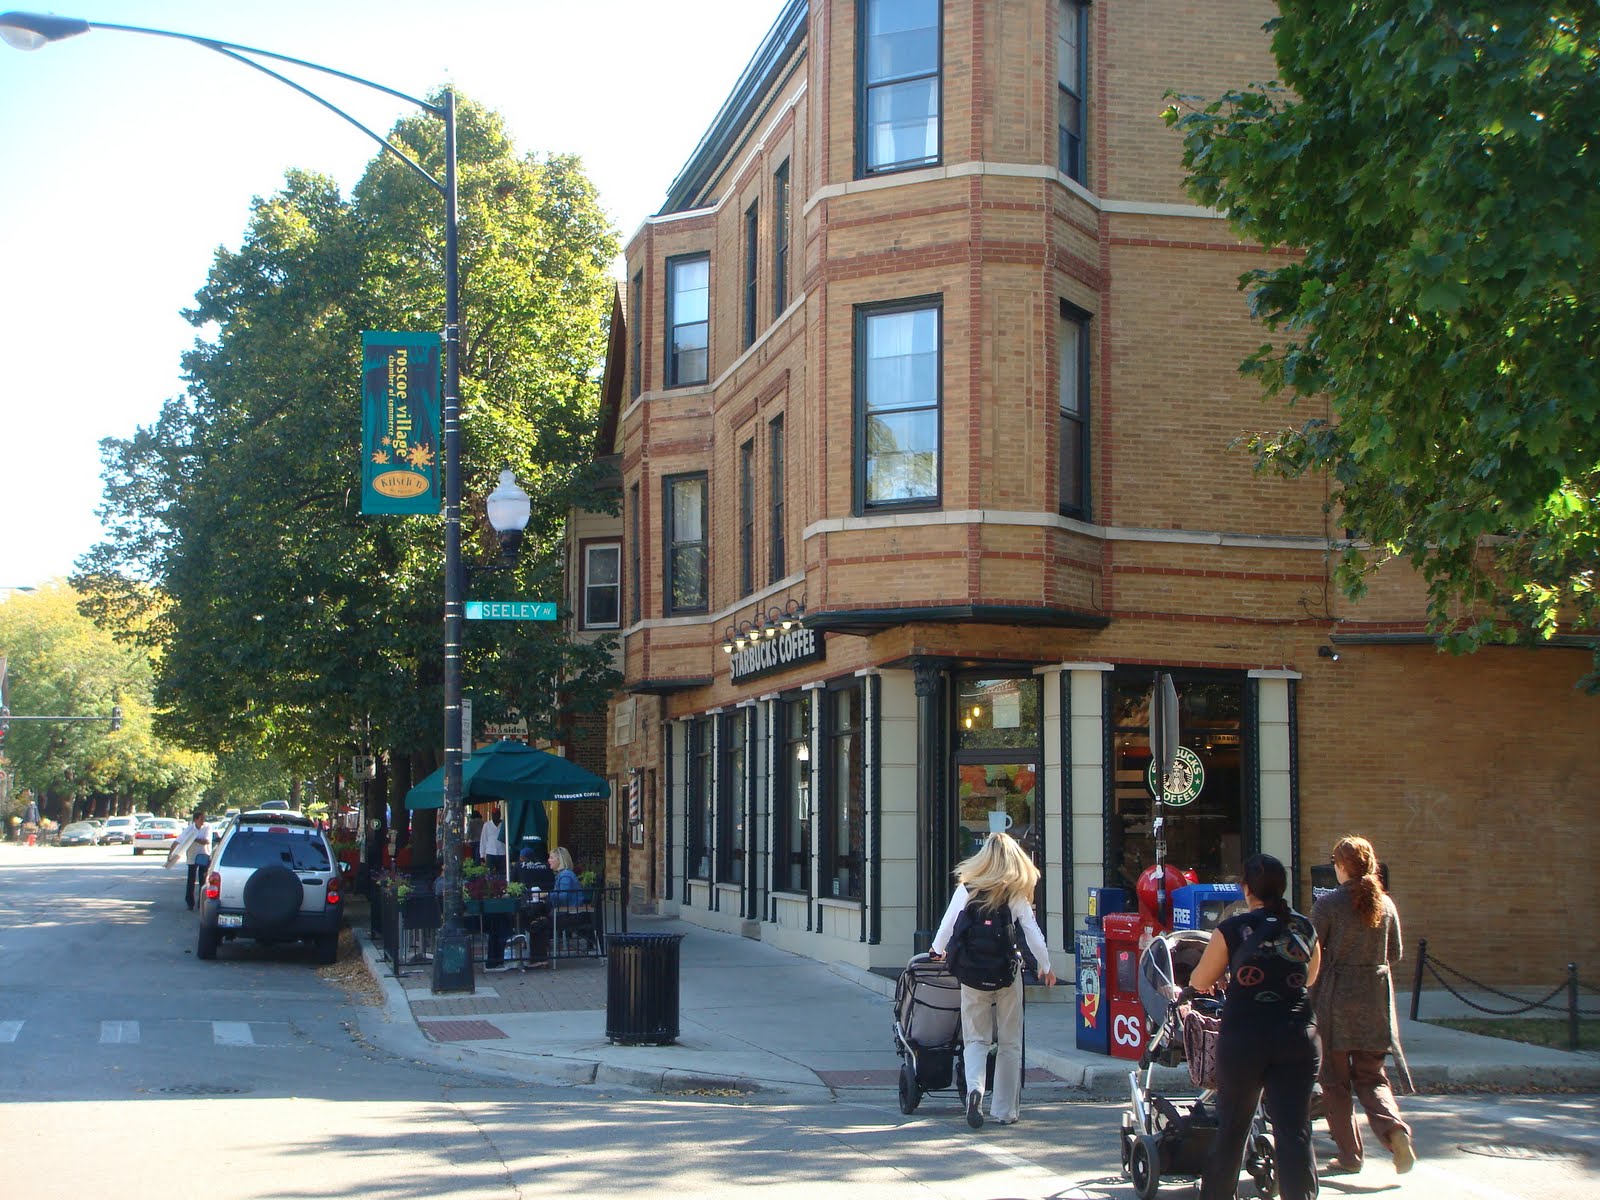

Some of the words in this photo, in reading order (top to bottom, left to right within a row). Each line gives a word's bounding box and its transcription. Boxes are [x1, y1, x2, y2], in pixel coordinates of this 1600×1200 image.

[388, 355, 396, 387] chamber
[396, 349, 408, 400] roscoe
[388, 388, 396, 397] of
[392, 405, 412, 457] village
[482, 603, 541, 618] SEELEY
[542, 607, 552, 616] AV
[730, 638, 777, 679] STARBUCKS
[779, 628, 816, 663] COFFEE
[503, 726, 527, 734] sides
[1163, 787, 1196, 804] OFFEE
[1212, 883, 1238, 892] FREE
[1173, 907, 1191, 925] FREE
[1113, 1013, 1141, 1048] CS
